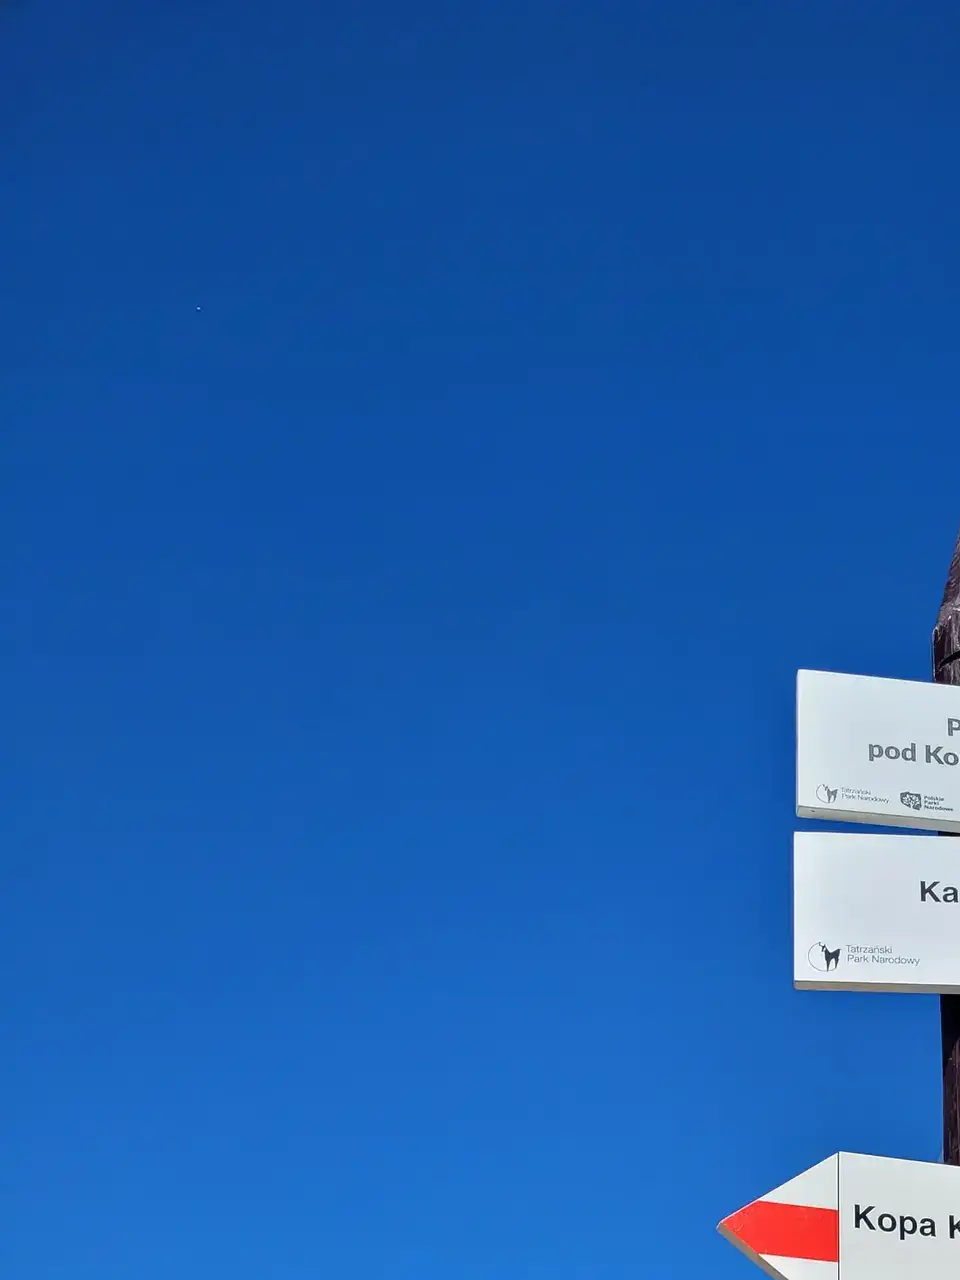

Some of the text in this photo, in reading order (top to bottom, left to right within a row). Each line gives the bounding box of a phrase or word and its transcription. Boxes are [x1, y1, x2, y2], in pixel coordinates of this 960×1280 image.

[868, 742, 917, 763] pod
[845, 944, 893, 954] Tatrzański
[847, 954, 920, 967] Park Narodowy
[853, 1203, 937, 1241] Kopa
